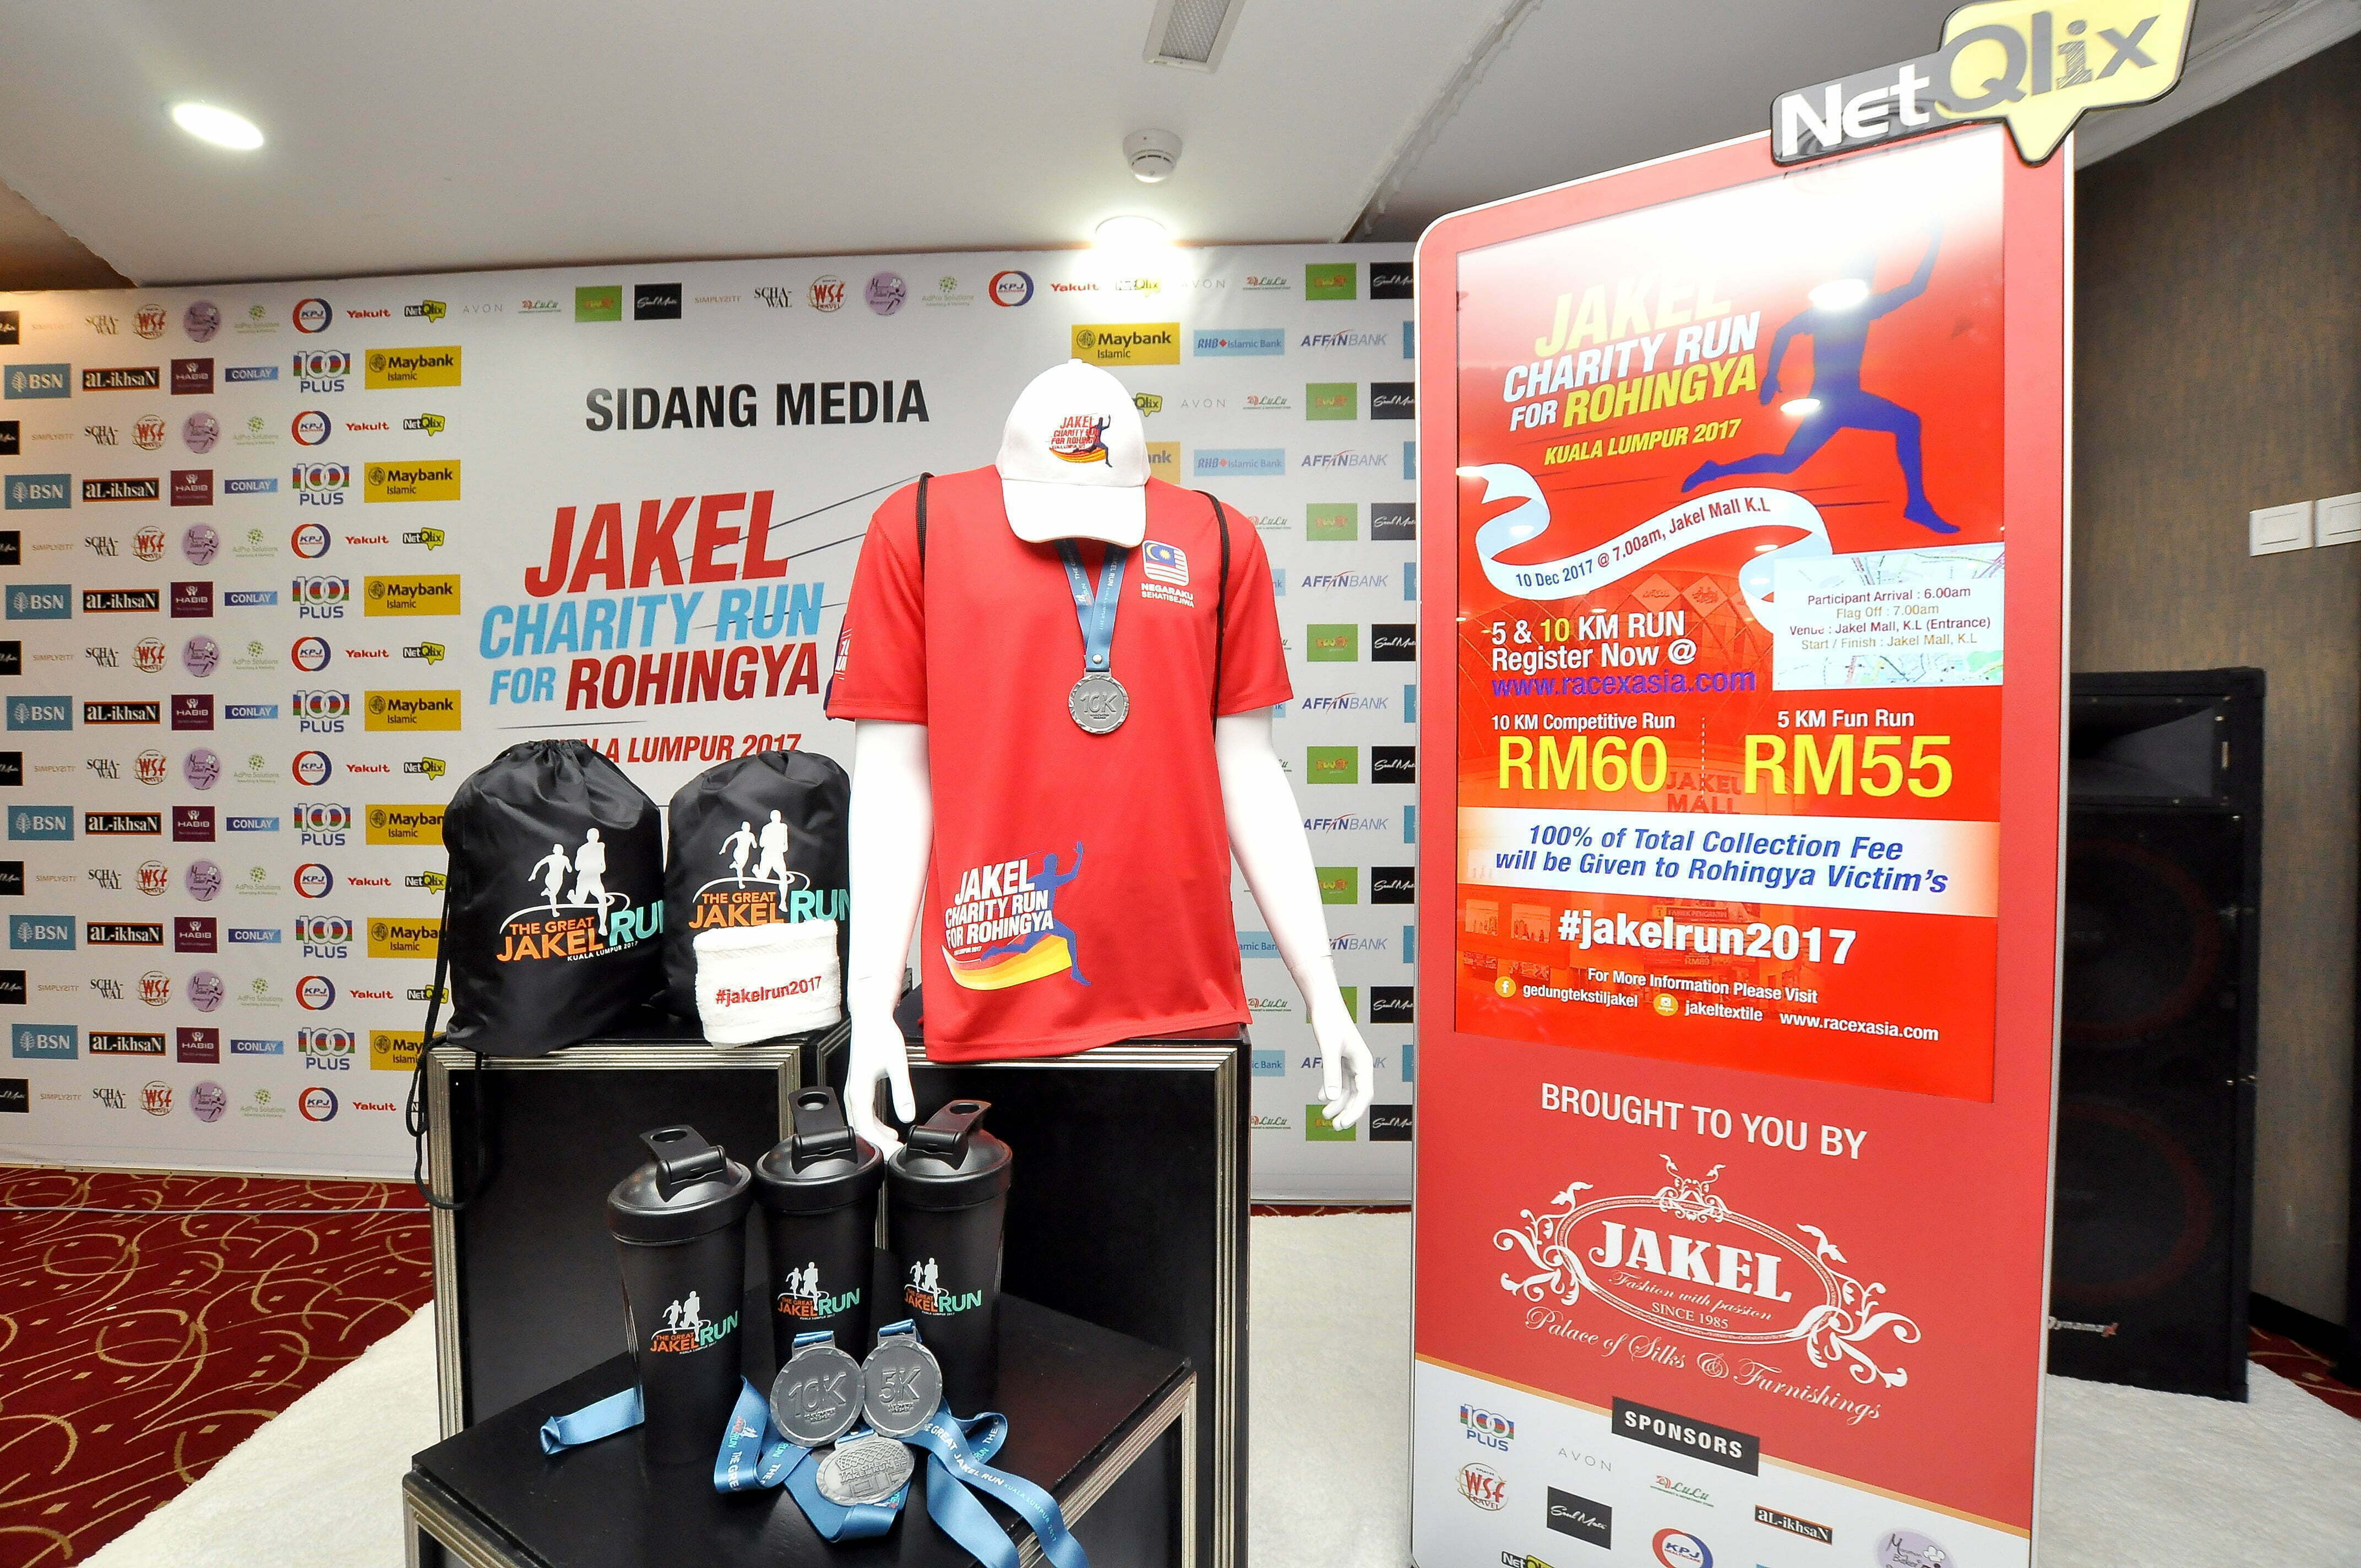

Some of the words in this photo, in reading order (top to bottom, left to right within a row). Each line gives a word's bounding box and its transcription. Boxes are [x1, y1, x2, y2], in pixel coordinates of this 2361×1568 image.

[1051, 282, 1100, 292] Yakult
[346, 309, 391, 319] Yakult
[1535, 275, 1733, 358] JAKEL
[1097, 331, 1172, 352] Maybank
[1097, 349, 1131, 358] Islamic
[1228, 340, 1258, 349] Islamic
[1260, 339, 1282, 349] Bank
[1503, 333, 1667, 402] CHARITY
[1673, 311, 1762, 367] RUN
[29, 373, 64, 389] BSN
[1509, 399, 1559, 432] FOR
[1563, 353, 1758, 429] ROHINGYA
[586, 383, 757, 432] SIDANG
[776, 379, 931, 427] MEDIA
[1181, 399, 1226, 408] AVON
[1060, 416, 1095, 429] JAKEL
[1544, 442, 1606, 466] KUALA
[1607, 426, 1690, 457] LUMPUR
[1691, 418, 1743, 444] 2017
[524, 489, 788, 598] JAKEL
[1515, 573, 1532, 587] 10
[1536, 573, 1560, 587] Dec
[1562, 559, 1594, 582] 2017
[1612, 529, 1667, 562] 7.00am,
[1669, 507, 1706, 535] Jakel
[1709, 498, 1742, 519] Mall
[1745, 496, 1771, 513] K.L
[1141, 582, 1195, 601] NEGARAKU
[1807, 592, 1871, 606] Participant
[1874, 590, 1913, 602] Arrival
[1924, 587, 1972, 599] 6.00am
[479, 591, 706, 660] CHARITY
[715, 581, 825, 643] RUN
[1835, 622, 1867, 635] Jakel
[1870, 621, 1900, 633] Mall,
[1903, 620, 1923, 631] K.L
[1926, 617, 1992, 631] (Entrance)
[1836, 608, 1862, 620] Flag
[1865, 606, 1883, 618] Off
[1893, 605, 1940, 616] 7.00am
[1492, 621, 1507, 645] 5
[1513, 619, 1532, 644] &
[1539, 618, 1570, 643] 10
[1578, 613, 1619, 641] KM
[1628, 610, 1685, 639] RUN
[345, 649, 390, 658] Yakult
[1802, 639, 1829, 650] Start
[1841, 637, 1876, 649] Finish
[1887, 635, 1920, 647] Jakel
[1957, 633, 1978, 644] K.L
[1492, 648, 1594, 676] Register
[1601, 643, 1661, 668] Now
[1667, 638, 1698, 664] @
[489, 666, 557, 705] FOR
[564, 642, 819, 712] ROHINGYA
[1491, 668, 1756, 698] www.racexasia.com
[31, 706, 65, 721] BSN
[231, 707, 273, 717] CONLAY
[297, 690, 346, 720] 100
[387, 698, 454, 714] Maybank
[300, 720, 345, 733] PLUS
[387, 714, 418, 724] Islamic
[1491, 715, 1510, 731] 10
[1514, 714, 1539, 731] KM
[1543, 712, 1638, 733] Competitive
[1642, 712, 1676, 730] Run
[1777, 711, 1789, 728] 5
[1793, 710, 1827, 728] KM
[1834, 710, 1870, 728] Fun
[1875, 710, 1916, 727] Run
[627, 736, 735, 763] LUMPUR
[1498, 735, 1668, 793] RM60
[1745, 733, 1954, 798] RM55
[1530, 825, 1593, 848] 100%
[1601, 827, 1628, 848] of
[1635, 828, 1695, 851] Total
[1702, 830, 1841, 857] Collection
[1850, 836, 1904, 861] Fee
[954, 858, 1035, 906] JAKEL
[1495, 850, 1537, 870] will
[1543, 851, 1572, 872] be
[1579, 852, 1647, 876] Given
[1655, 857, 1680, 878] to
[1688, 858, 1816, 890] Rohingya
[701, 892, 728, 905] THE
[731, 891, 776, 903] GREAT
[945, 896, 1009, 929] CHARITY
[1011, 889, 1049, 916] RUN
[509, 923, 541, 935] THE
[544, 916, 595, 934] GREAT
[688, 902, 785, 929] JAKEL
[945, 925, 964, 950] FOR
[966, 910, 1055, 946] ROHINGYA
[1557, 909, 1858, 965] #jakelrun2017
[496, 927, 605, 962] JAKEL
[567, 953, 594, 962] KUALA
[596, 945, 623, 956] LUMPUR
[623, 941, 639, 950] 2017
[715, 976, 823, 1008] #jakelrun2017
[1522, 984, 1639, 1008] gedungtekstiljakel
[1587, 968, 1610, 982] For
[1612, 970, 1647, 986] More
[1649, 973, 1730, 995] Information
[1733, 981, 1782, 1001] Please
[1785, 987, 1819, 1005] Visit
[1684, 1000, 1764, 1022] jakeltextile
[1779, 1011, 1940, 1042] www.racexasia.com
[1541, 1082, 1685, 1131] BROUGHT
[1690, 1105, 1733, 1139] TO
[1740, 1112, 1808, 1151] YOU
[1820, 1125, 1868, 1161] BY
[1588, 1219, 1793, 1304] JAKEL
[777, 1301, 818, 1317] JAKEL
[818, 1287, 861, 1316] RUN
[904, 1292, 938, 1313] JAKEL
[938, 1289, 982, 1313] RUN
[1607, 1269, 1675, 1300] Fashion
[1678, 1290, 1711, 1308] with
[1709, 1298, 1774, 1322] passion
[700, 1310, 738, 1347] RUN
[1651, 1301, 1695, 1323] SINCE
[1699, 1312, 1729, 1331] 1985
[650, 1337, 700, 1353] JAKEL
[1525, 1305, 1600, 1347] Palace
[1602, 1331, 1627, 1358] of
[1628, 1334, 1686, 1370] Silks
[1732, 1357, 1883, 1426] Furnishings
[788, 1371, 847, 1418] 10K
[878, 1368, 921, 1404] 5K
[1464, 1403, 1511, 1439] 100
[1624, 1409, 1744, 1460] SPONSORS
[728, 1431, 741, 1449] RUN
[1466, 1429, 1509, 1452] PLUS
[729, 1451, 743, 1465] THE
[930, 1425, 959, 1451] GREAT
[954, 1453, 980, 1477] JAKEL
[982, 1473, 1005, 1486] RUN
[1558, 1447, 1613, 1472] AVON
[1663, 1542, 1701, 1559] KPJ
